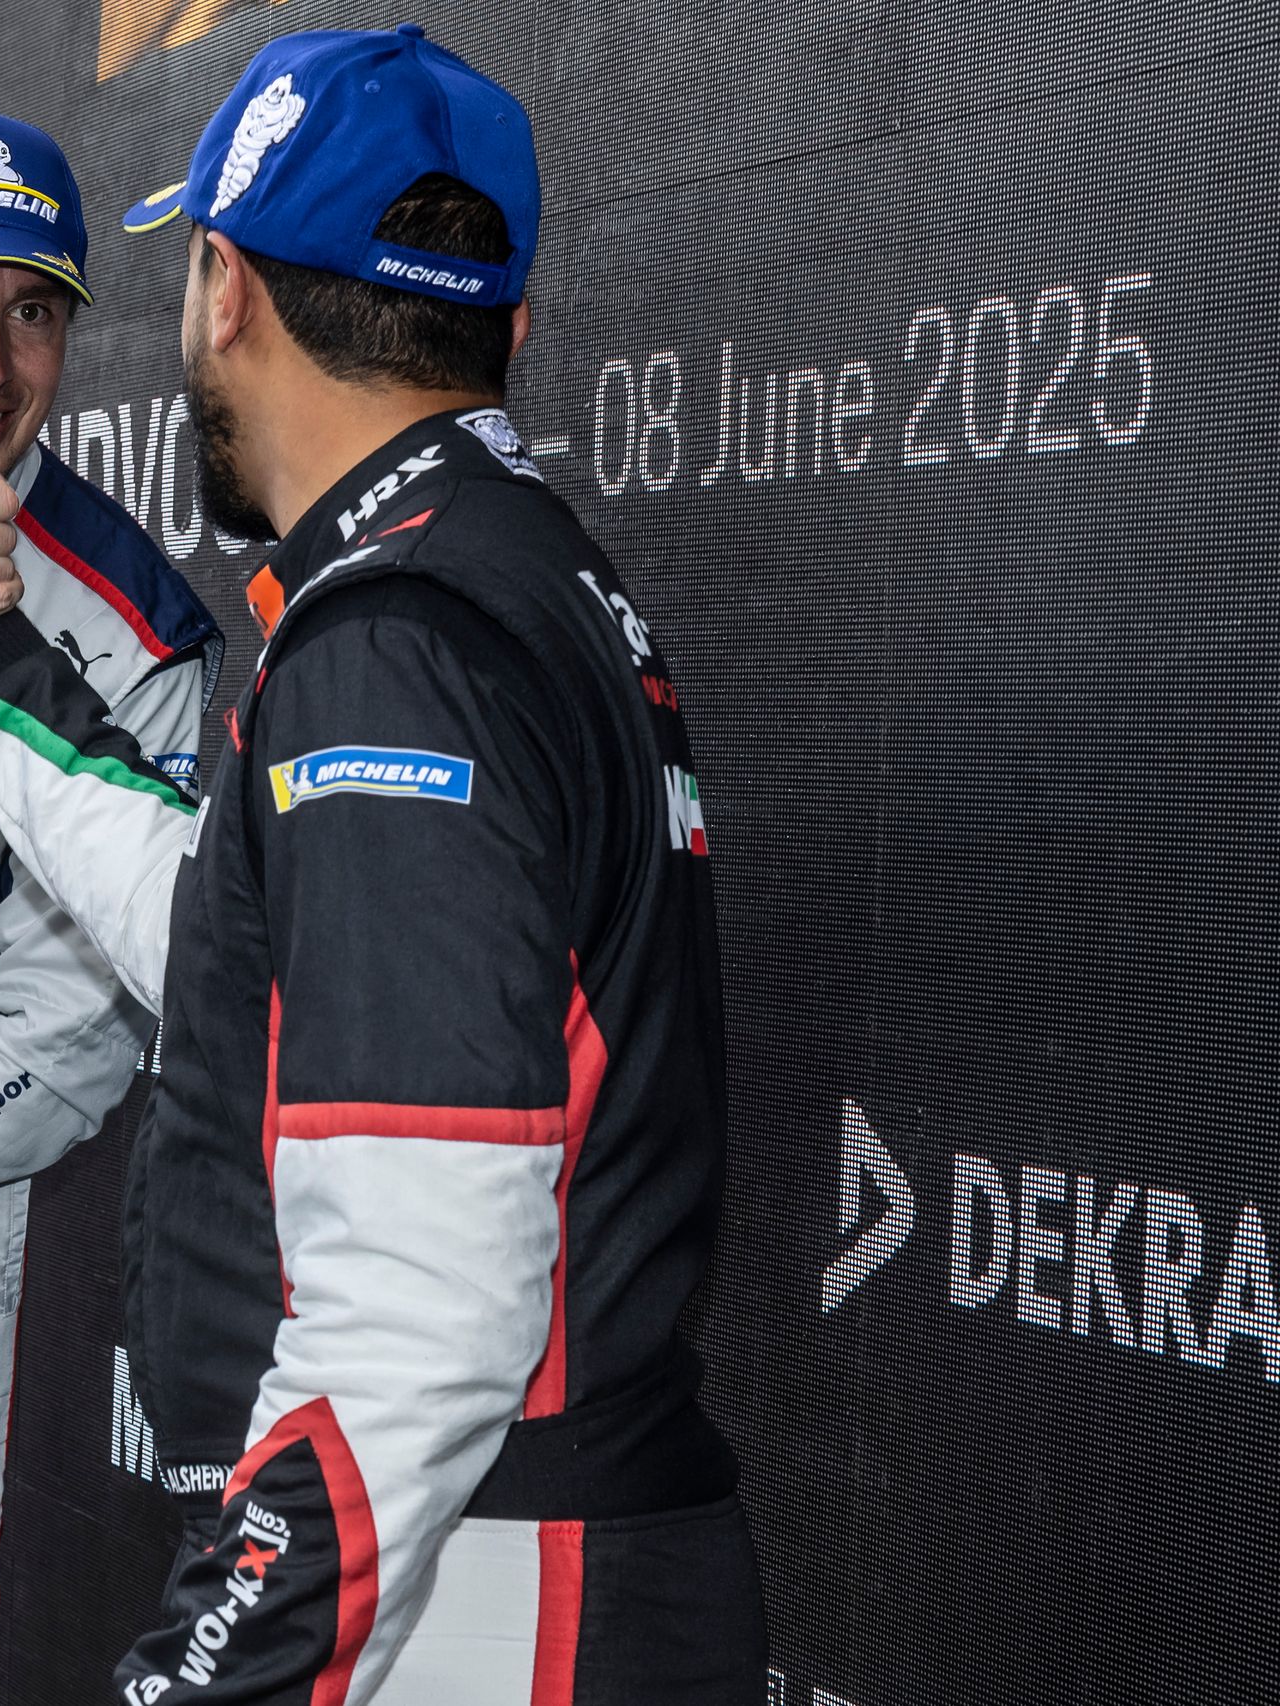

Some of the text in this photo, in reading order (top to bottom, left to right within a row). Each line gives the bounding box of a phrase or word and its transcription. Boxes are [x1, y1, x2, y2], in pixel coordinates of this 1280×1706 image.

[376, 256, 484, 294] MICHELIN
[594, 350, 681, 497] 08
[700, 340, 872, 487] June
[903, 272, 1152, 466] 2025
[337, 443, 446, 543] HRX
[315, 760, 453, 786] MICHELIN
[950, 1152, 1280, 1384] DEKRA
